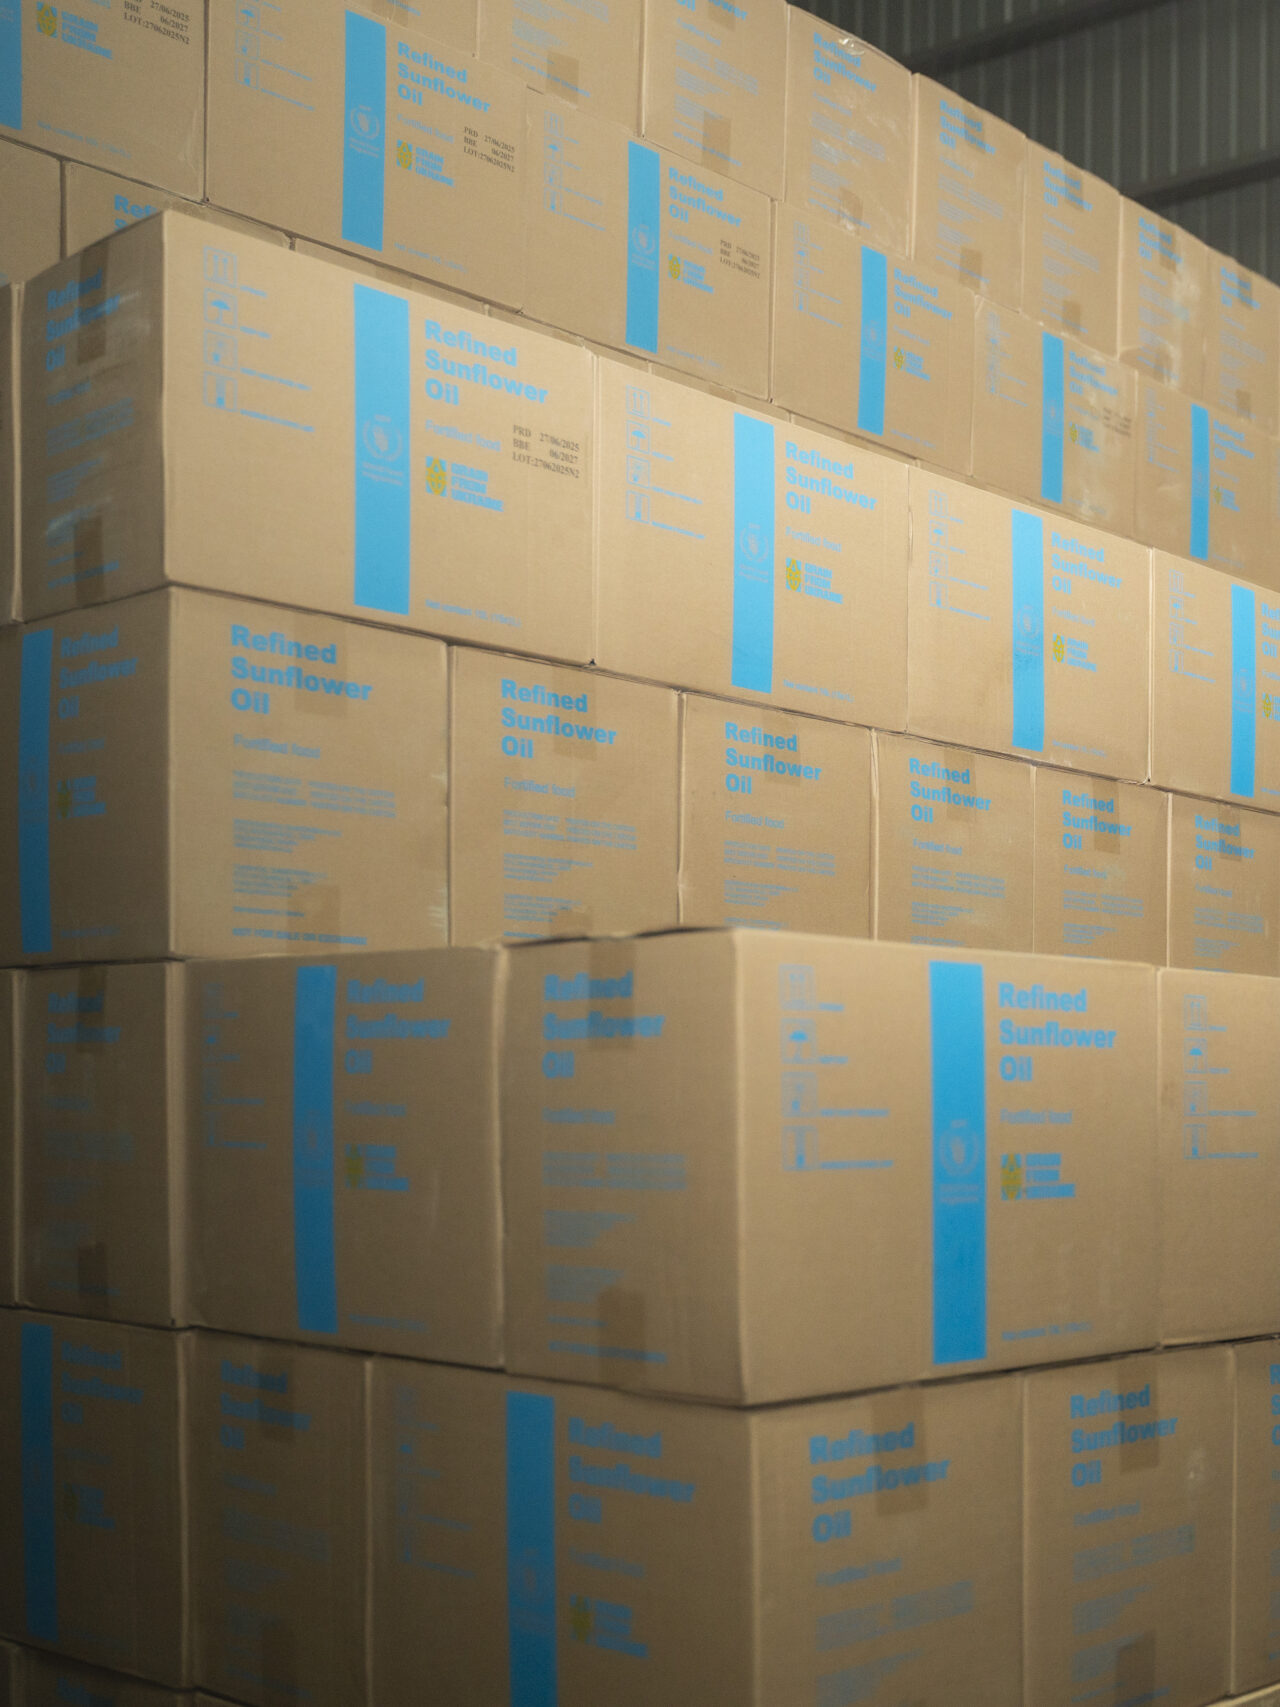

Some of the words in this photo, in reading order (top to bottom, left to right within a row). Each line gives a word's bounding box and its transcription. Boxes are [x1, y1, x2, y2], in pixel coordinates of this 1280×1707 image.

[124, 1, 140, 14] BBE
[160, 16, 188, 32] 06/2027
[150, 0, 190, 22] 27/06/2025
[124, 12, 190, 44] LOT:27062025N2
[398, 45, 467, 83] Refined
[398, 64, 490, 109] Sunflower
[398, 84, 422, 105] Oil
[464, 126, 478, 137] PRD
[669, 168, 723, 201] Refined
[669, 187, 741, 227] Sunflower
[669, 207, 688, 223] Oil
[425, 320, 517, 367] Refined
[426, 349, 548, 403] Sunflower
[426, 379, 459, 405] Oil
[512, 424, 531, 437] PRD
[786, 441, 854, 479] Refined
[786, 466, 877, 510] Sunflower
[786, 492, 810, 514] Oil
[1051, 532, 1104, 562] Refined
[1052, 554, 1122, 588] Sunflower
[1052, 575, 1071, 594] Oil
[231, 625, 336, 664] Refined
[232, 656, 372, 700] Sunflower
[231, 688, 269, 714] Oil
[502, 679, 587, 712] Refined
[502, 707, 616, 744] Sunflower
[725, 722, 797, 751] Refined
[502, 736, 533, 758] Oil
[726, 748, 821, 780] Sunflower
[909, 758, 970, 784] Refined
[504, 779, 550, 794] Fortified
[552, 784, 576, 797] food
[726, 774, 752, 794] Oil
[910, 781, 991, 810] Sunflower
[911, 804, 933, 823] Oil
[1063, 790, 1114, 813] Refined
[1063, 811, 1132, 836] Sunflower
[1195, 815, 1239, 836] Refined
[1063, 833, 1082, 849] Oil
[1196, 834, 1254, 858] Sunflower
[1195, 855, 1212, 870] Oil
[999, 983, 1087, 1012] Refined
[1000, 1020, 1116, 1048] Sunflower
[1001, 1057, 1033, 1081] Oil
[1070, 1384, 1150, 1419] Refined
[809, 1423, 914, 1464] Refined
[1071, 1418, 1178, 1453] Sunflower
[812, 1460, 950, 1504] Sunflower
[1071, 1460, 1101, 1487] Oil
[812, 1511, 851, 1542] Oil
